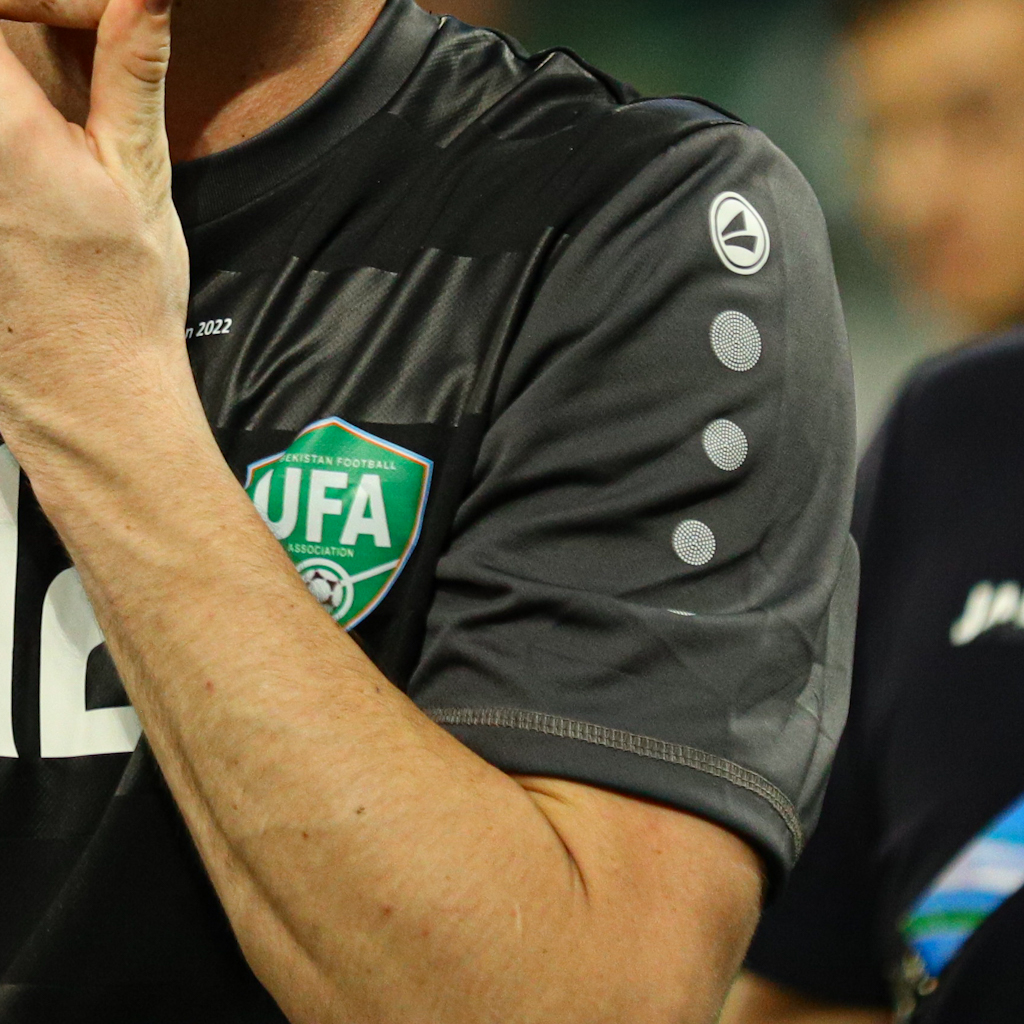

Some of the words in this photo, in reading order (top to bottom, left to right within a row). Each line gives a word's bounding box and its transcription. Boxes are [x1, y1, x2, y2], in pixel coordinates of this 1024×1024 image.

[196, 318, 232, 337] 2022
[336, 457, 397, 470] FOOTBALL
[253, 467, 391, 548] UFA
[287, 542, 355, 557] ASSOCIATION
